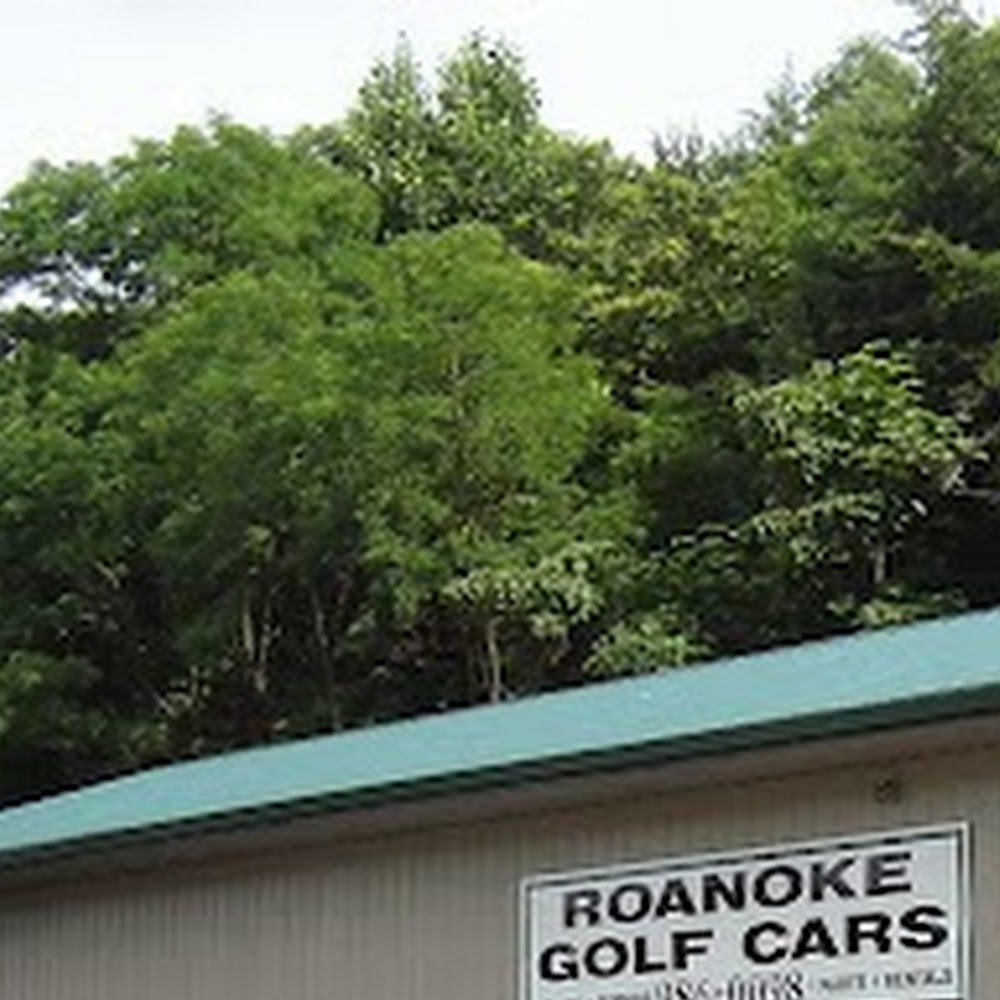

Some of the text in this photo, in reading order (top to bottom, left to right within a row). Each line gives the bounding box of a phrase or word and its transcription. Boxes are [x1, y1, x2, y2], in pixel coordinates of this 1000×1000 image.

[563, 852, 912, 928] ROANOKE
[540, 905, 949, 982] GOLF CARS
